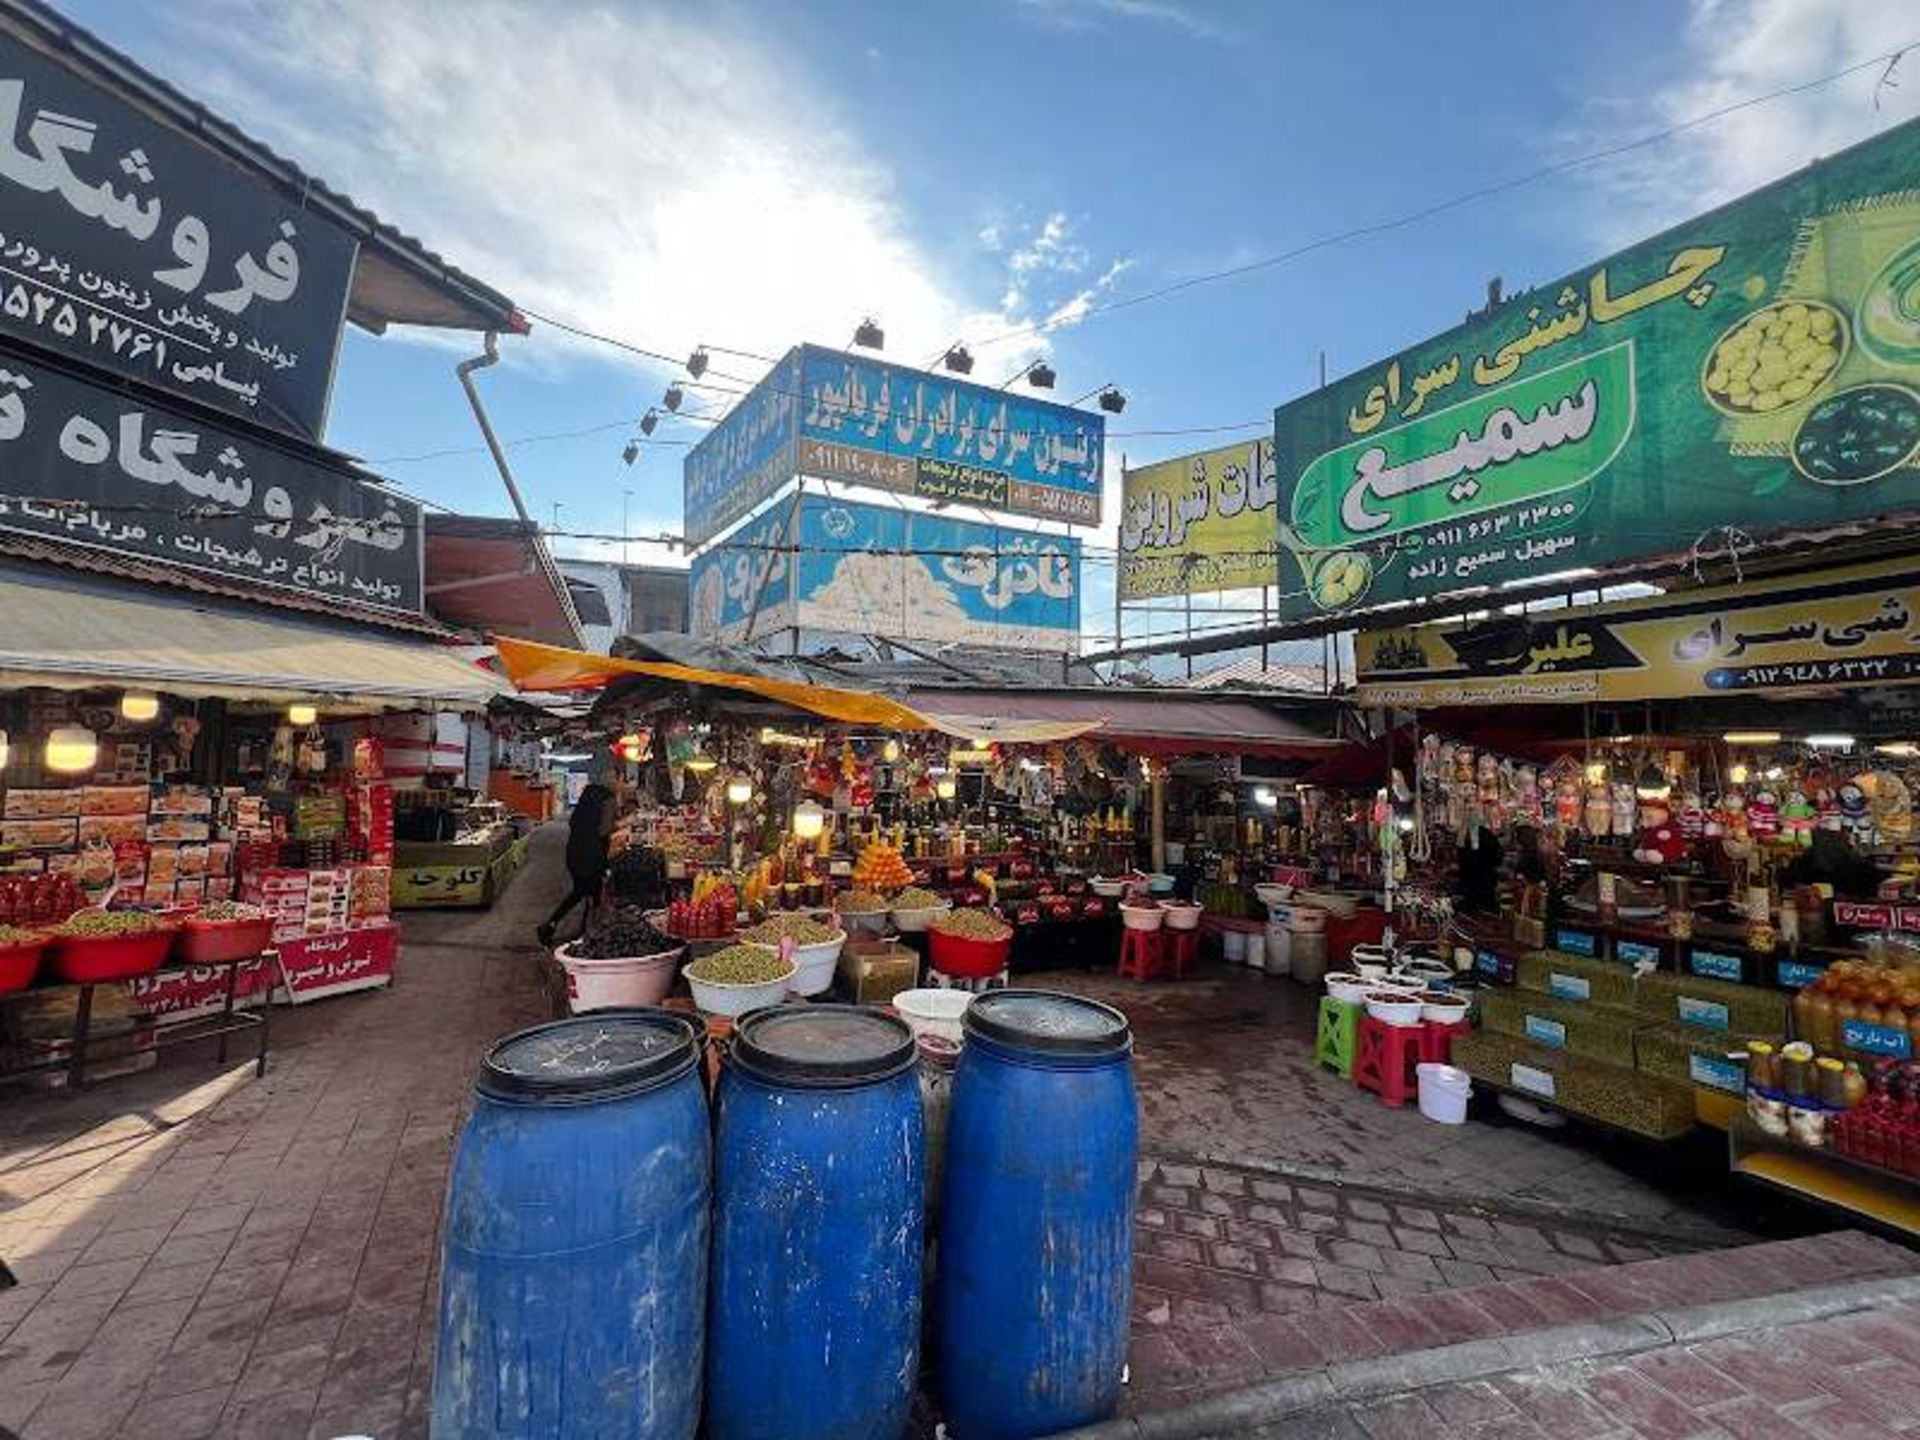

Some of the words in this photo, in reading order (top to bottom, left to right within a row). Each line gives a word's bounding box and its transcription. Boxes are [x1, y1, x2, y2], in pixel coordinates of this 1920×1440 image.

[78, 269, 152, 310] زیتون
[158, 303, 222, 342] پخش
[1472, 244, 1728, 385] چاشنی
[224, 331, 239, 348] و
[245, 338, 300, 369] تولید
[1347, 352, 1461, 434] سرای
[1341, 378, 1598, 532] سمیع
[59, 412, 405, 551] فروشگاه
[1455, 547, 1506, 577] سمیع
[1516, 533, 1576, 560] سهیل
[293, 563, 345, 586] انواع
[1408, 556, 1448, 579] زاده
[352, 575, 401, 600] تولید
[1672, 617, 1818, 660] سرای
